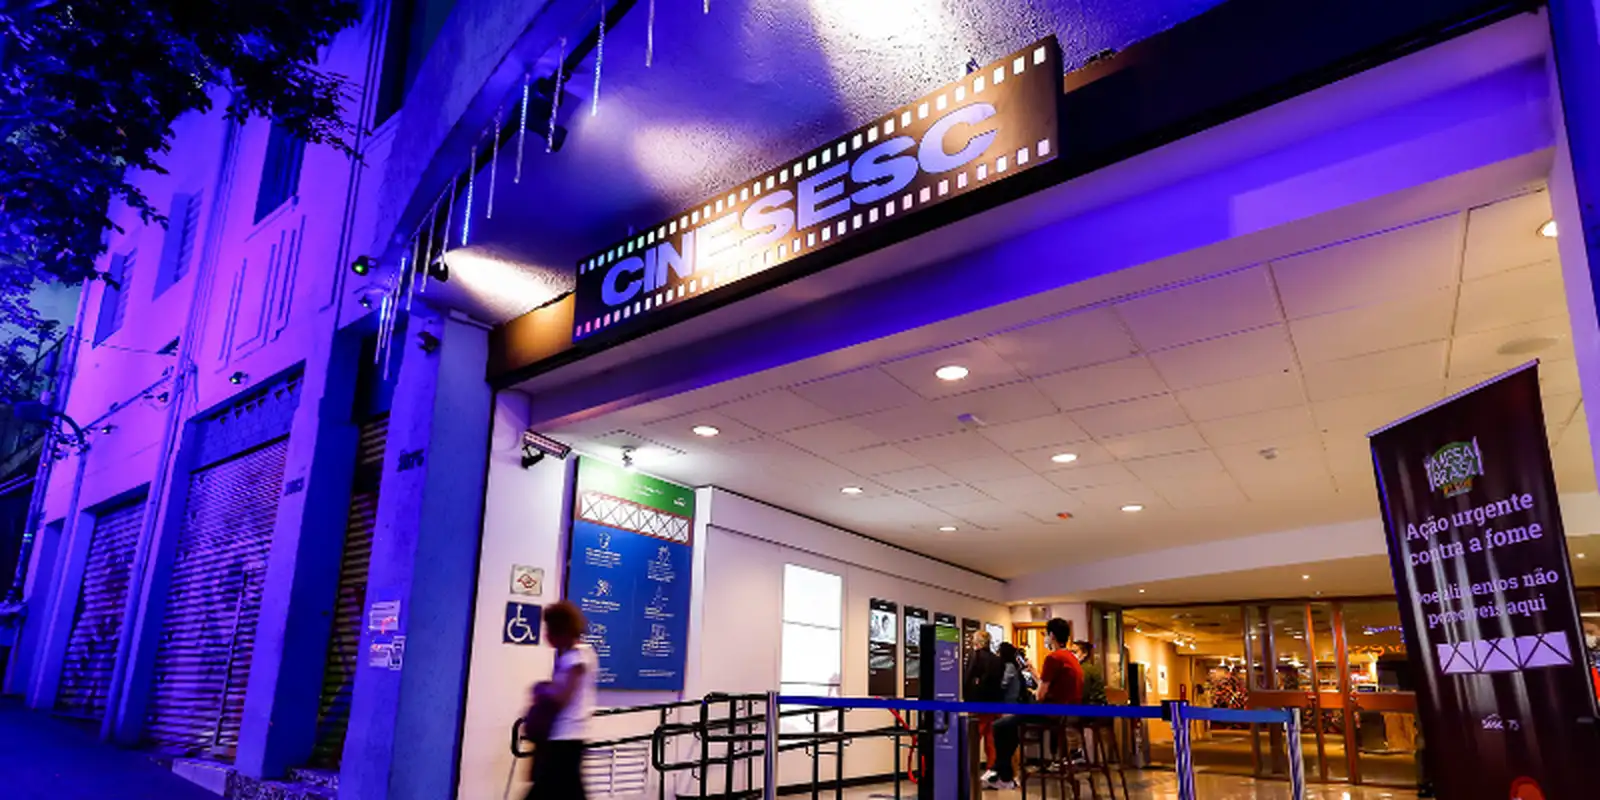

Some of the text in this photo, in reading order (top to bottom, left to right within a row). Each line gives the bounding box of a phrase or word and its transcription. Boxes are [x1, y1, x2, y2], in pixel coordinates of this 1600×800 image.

[601, 102, 998, 307] CINESESC
[1431, 446, 1475, 472] MESA
[1433, 460, 1476, 487] BRASIL
[1406, 492, 1534, 541] Ação urgente
[1409, 522, 1543, 566] contra a fome
[1523, 567, 1560, 587] não
[1507, 593, 1548, 617] aqui
